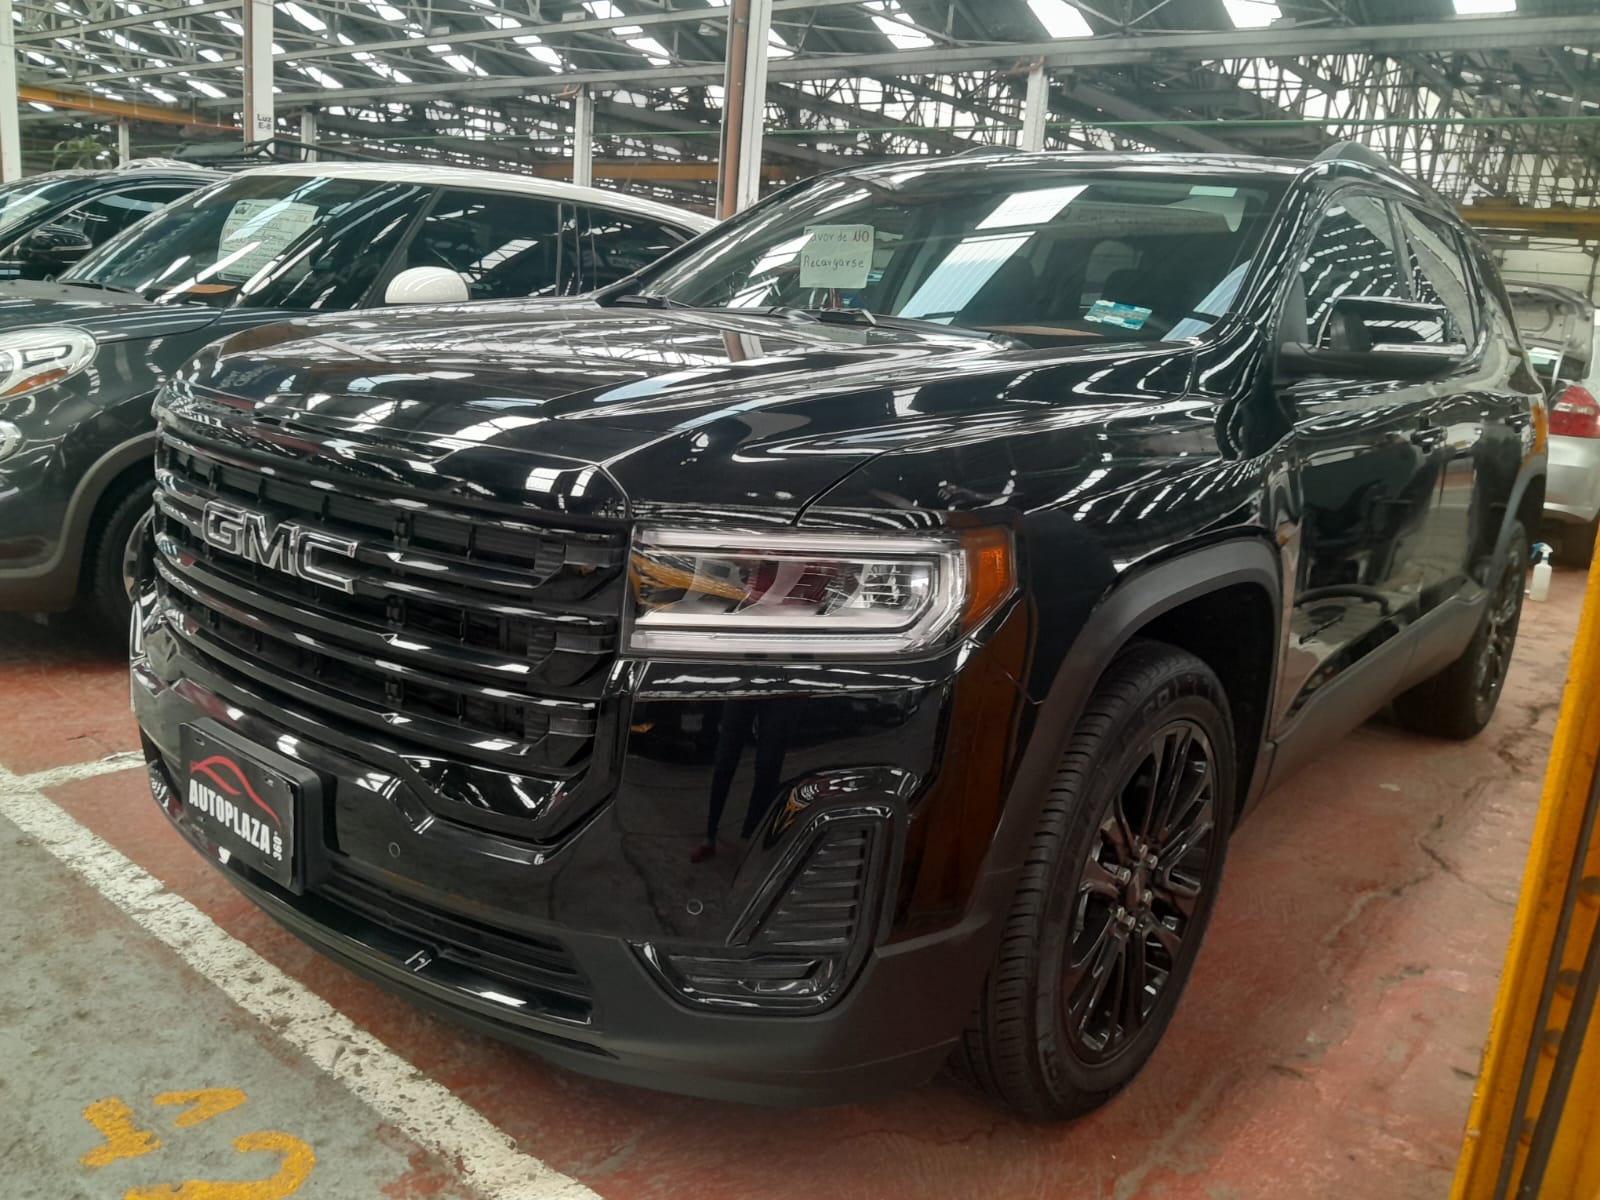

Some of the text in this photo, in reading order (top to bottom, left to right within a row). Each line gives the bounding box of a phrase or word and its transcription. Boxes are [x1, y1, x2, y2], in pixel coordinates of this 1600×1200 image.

[838, 231, 847, 242] de
[852, 230, 870, 242] NO
[803, 255, 864, 270] Recargarse
[202, 501, 357, 595] GMC
[189, 778, 270, 854] AUTOPLAZA
